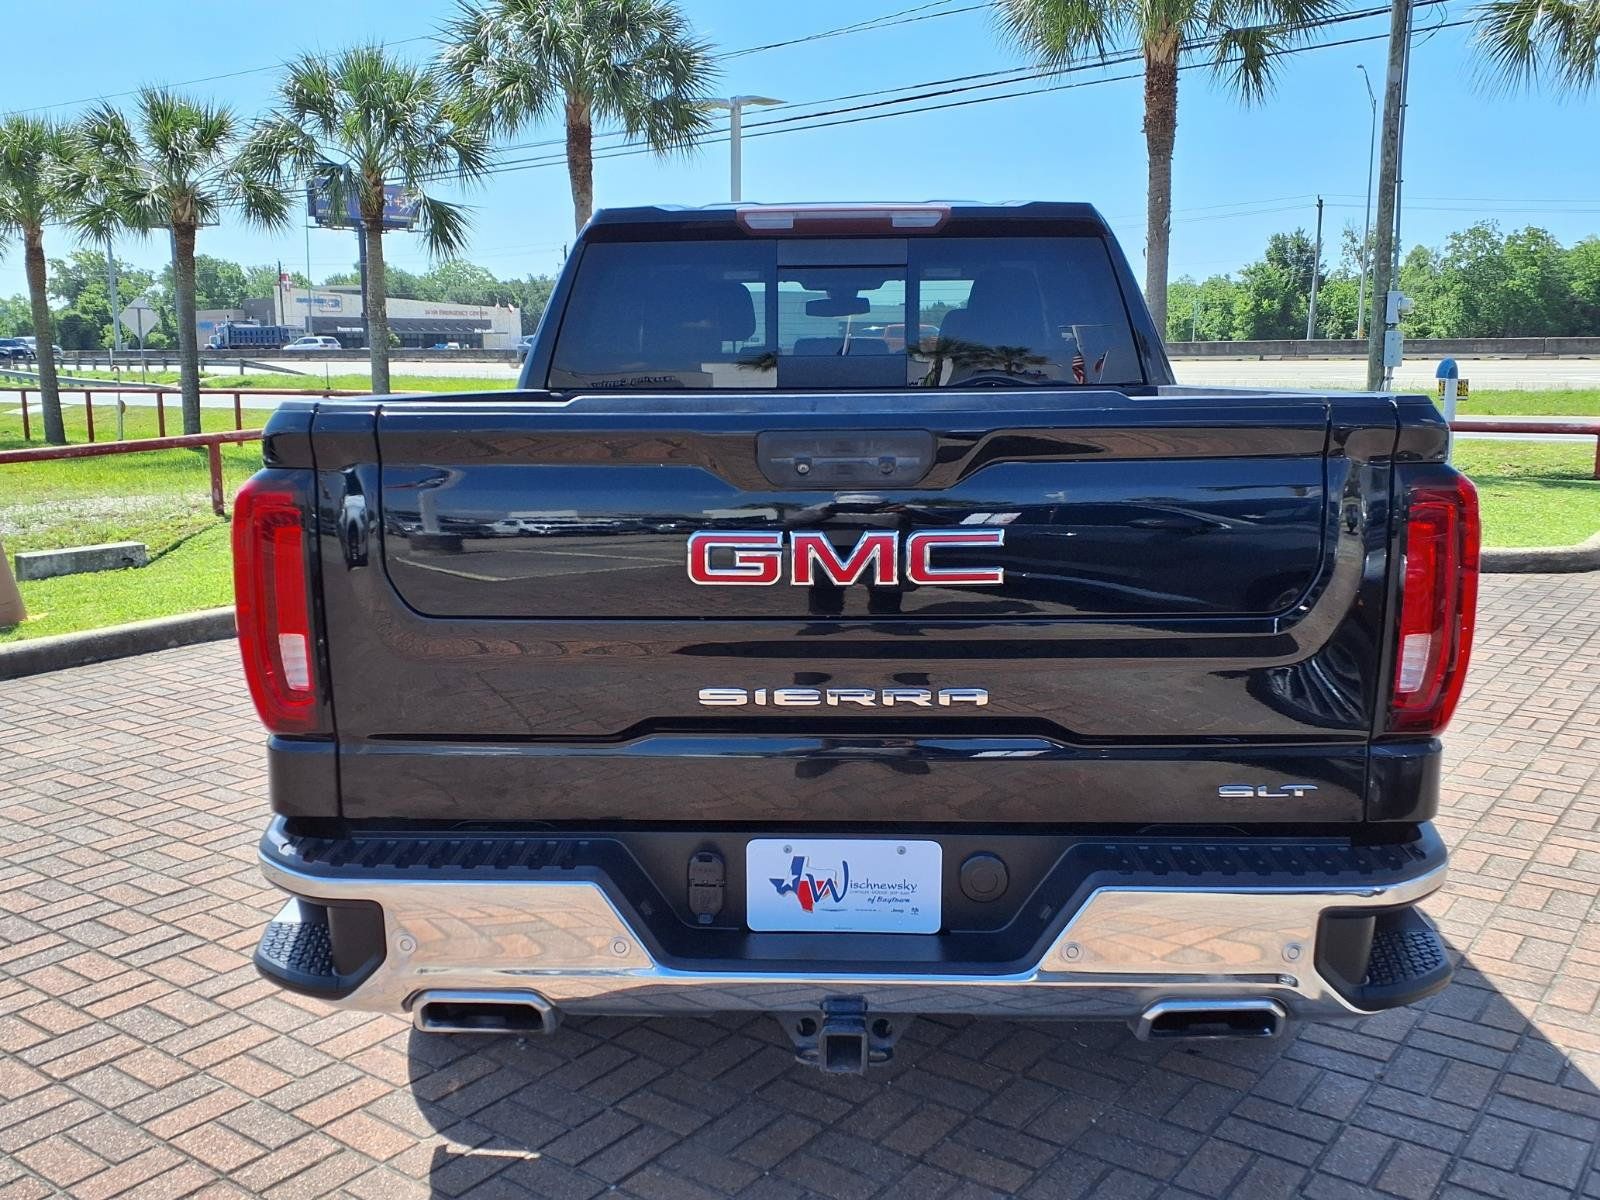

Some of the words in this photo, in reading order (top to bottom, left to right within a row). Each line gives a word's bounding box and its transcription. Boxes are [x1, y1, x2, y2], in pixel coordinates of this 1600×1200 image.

[687, 529, 1005, 586] GMC
[698, 687, 989, 706] SIERRA
[1218, 784, 1318, 797] SLT
